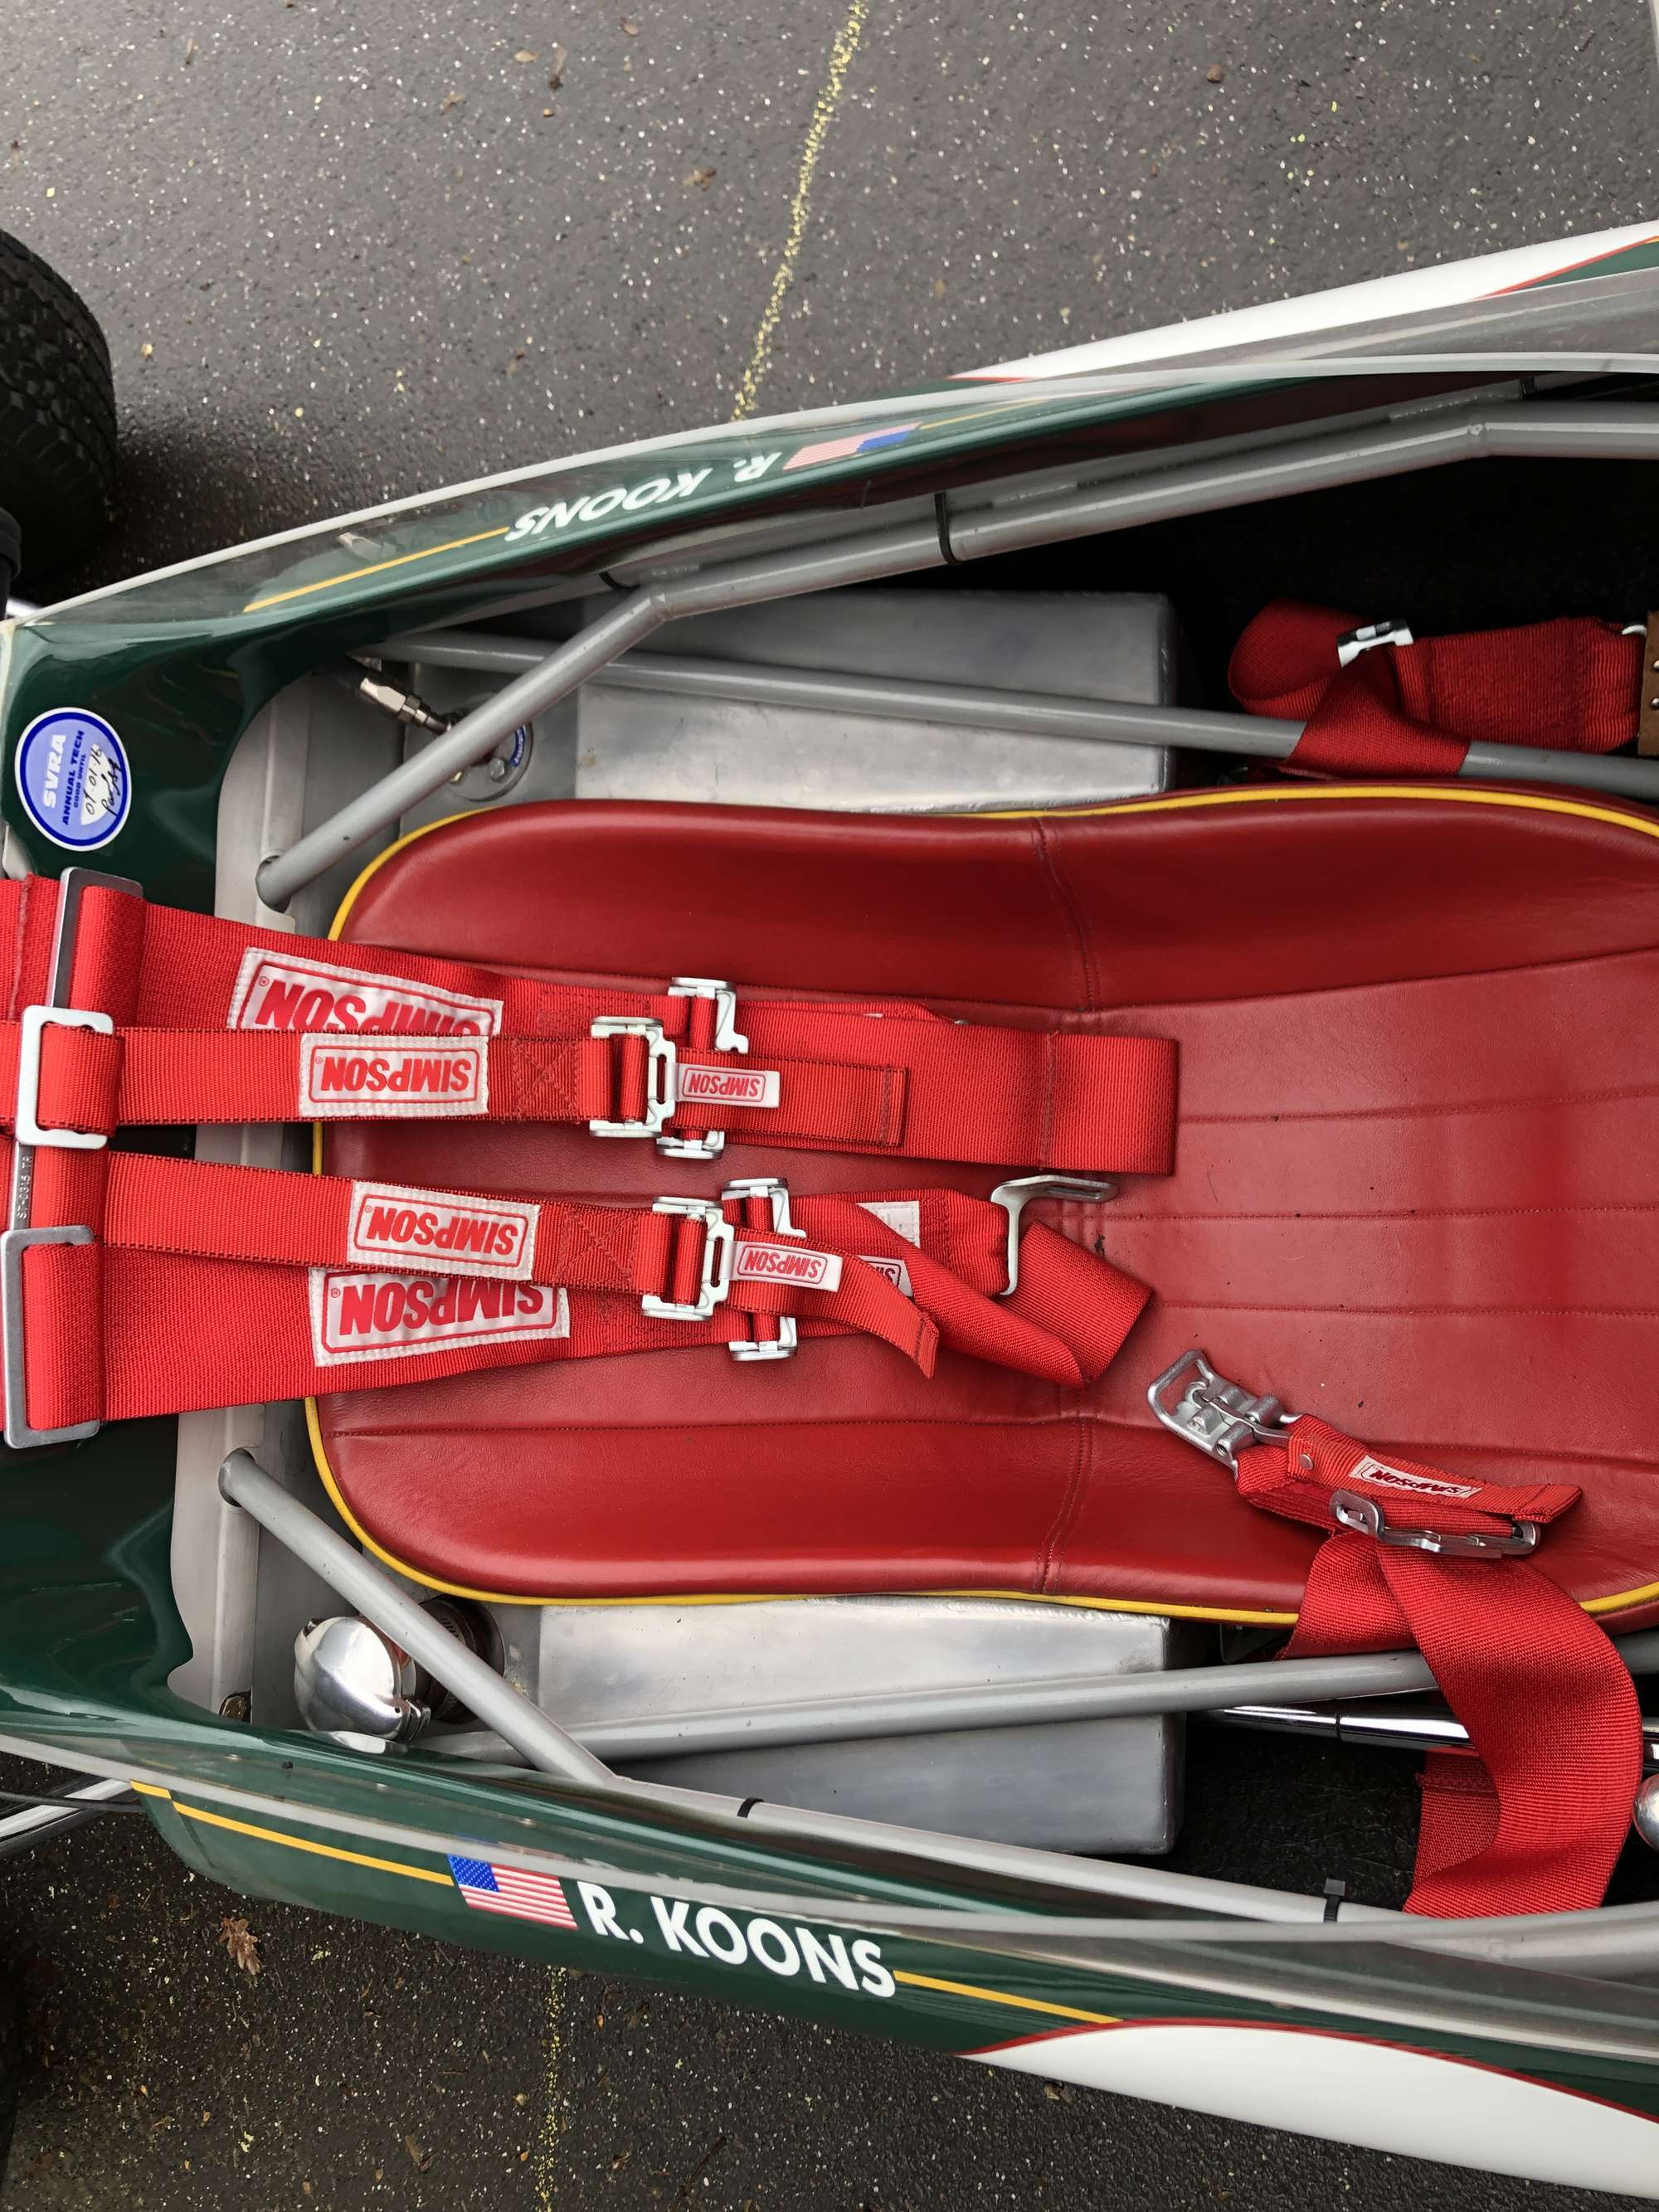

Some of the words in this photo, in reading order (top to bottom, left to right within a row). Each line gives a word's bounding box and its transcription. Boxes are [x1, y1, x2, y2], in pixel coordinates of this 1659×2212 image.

[733, 452, 782, 482] R.
[504, 467, 713, 542] KOONS
[43, 735, 66, 809] SVRA
[62, 771, 75, 825] ANNUAL
[71, 730, 85, 765] TECH
[73, 783, 81, 808] GOOD
[78, 754, 86, 780] UNTIL
[319, 1056, 471, 1092] SIMPSON
[688, 1072, 760, 1097] SIMPSON
[365, 1205, 519, 1256] SIMPSON
[743, 1250, 824, 1278] SIMPSON
[338, 1285, 544, 1335] SIMPSON
[1370, 1470, 1461, 1494] SIMPSON
[577, 1880, 644, 1945] R.
[649, 1895, 896, 1998] KOONS
